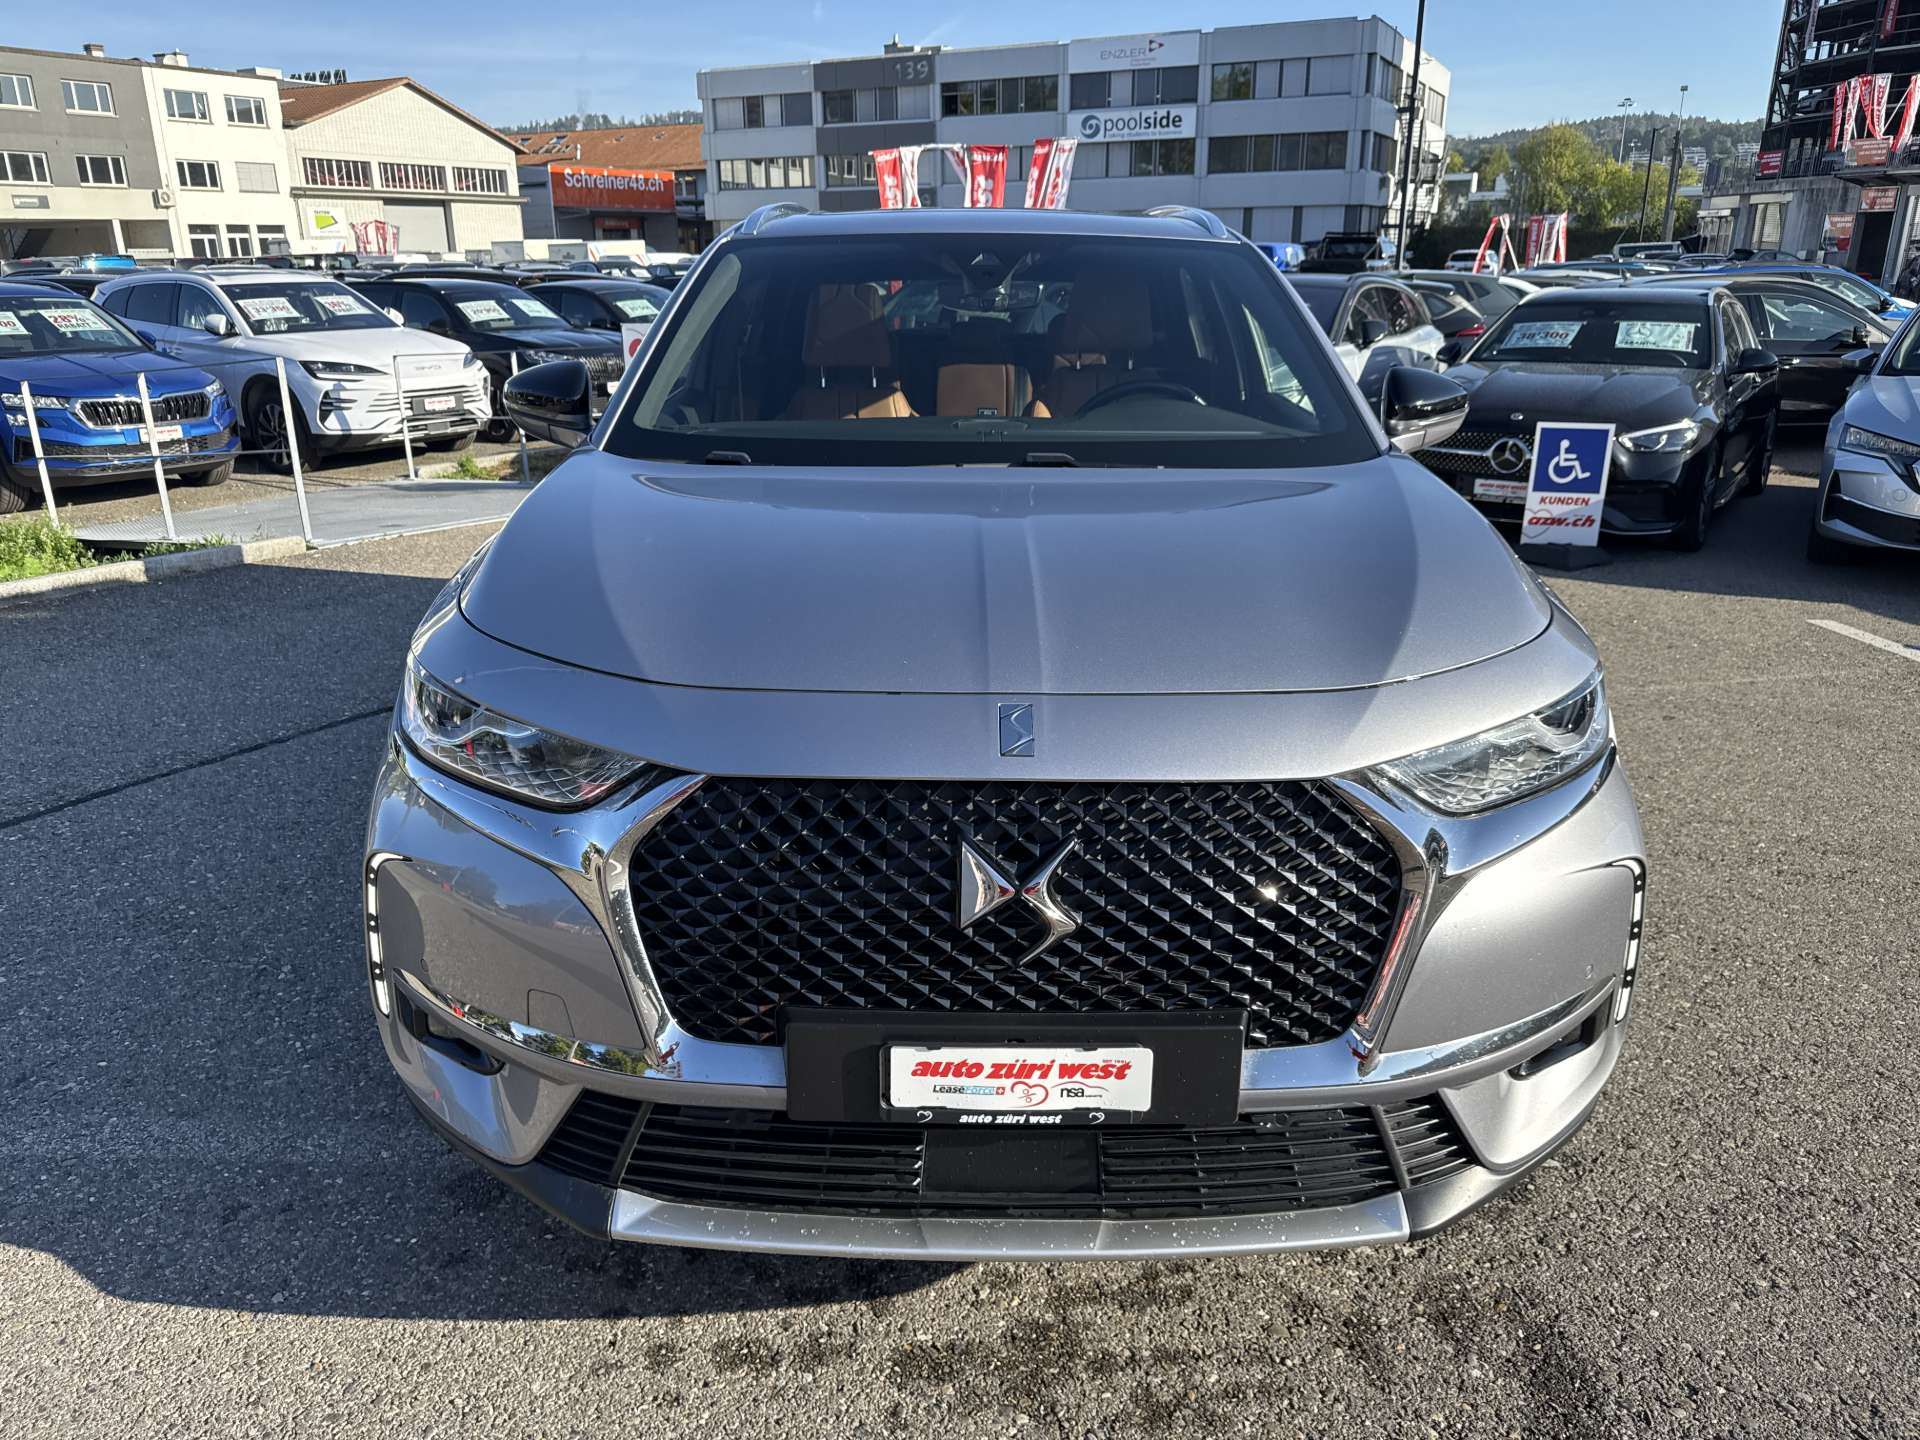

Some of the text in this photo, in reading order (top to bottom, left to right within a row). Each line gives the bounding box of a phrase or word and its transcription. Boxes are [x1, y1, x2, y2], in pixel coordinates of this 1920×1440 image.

[1100, 48, 1147, 60] ENZLER
[896, 61, 929, 79] 139
[1104, 110, 1183, 138] poolside
[563, 167, 665, 192] Schreiner48.ch
[1540, 496, 1590, 506] KUNDEN
[1528, 514, 1595, 528] azw.ch
[911, 1059, 1132, 1080] auto züri west
[1060, 1087, 1085, 1098] nsa
[959, 1113, 1063, 1124] auto züri west
